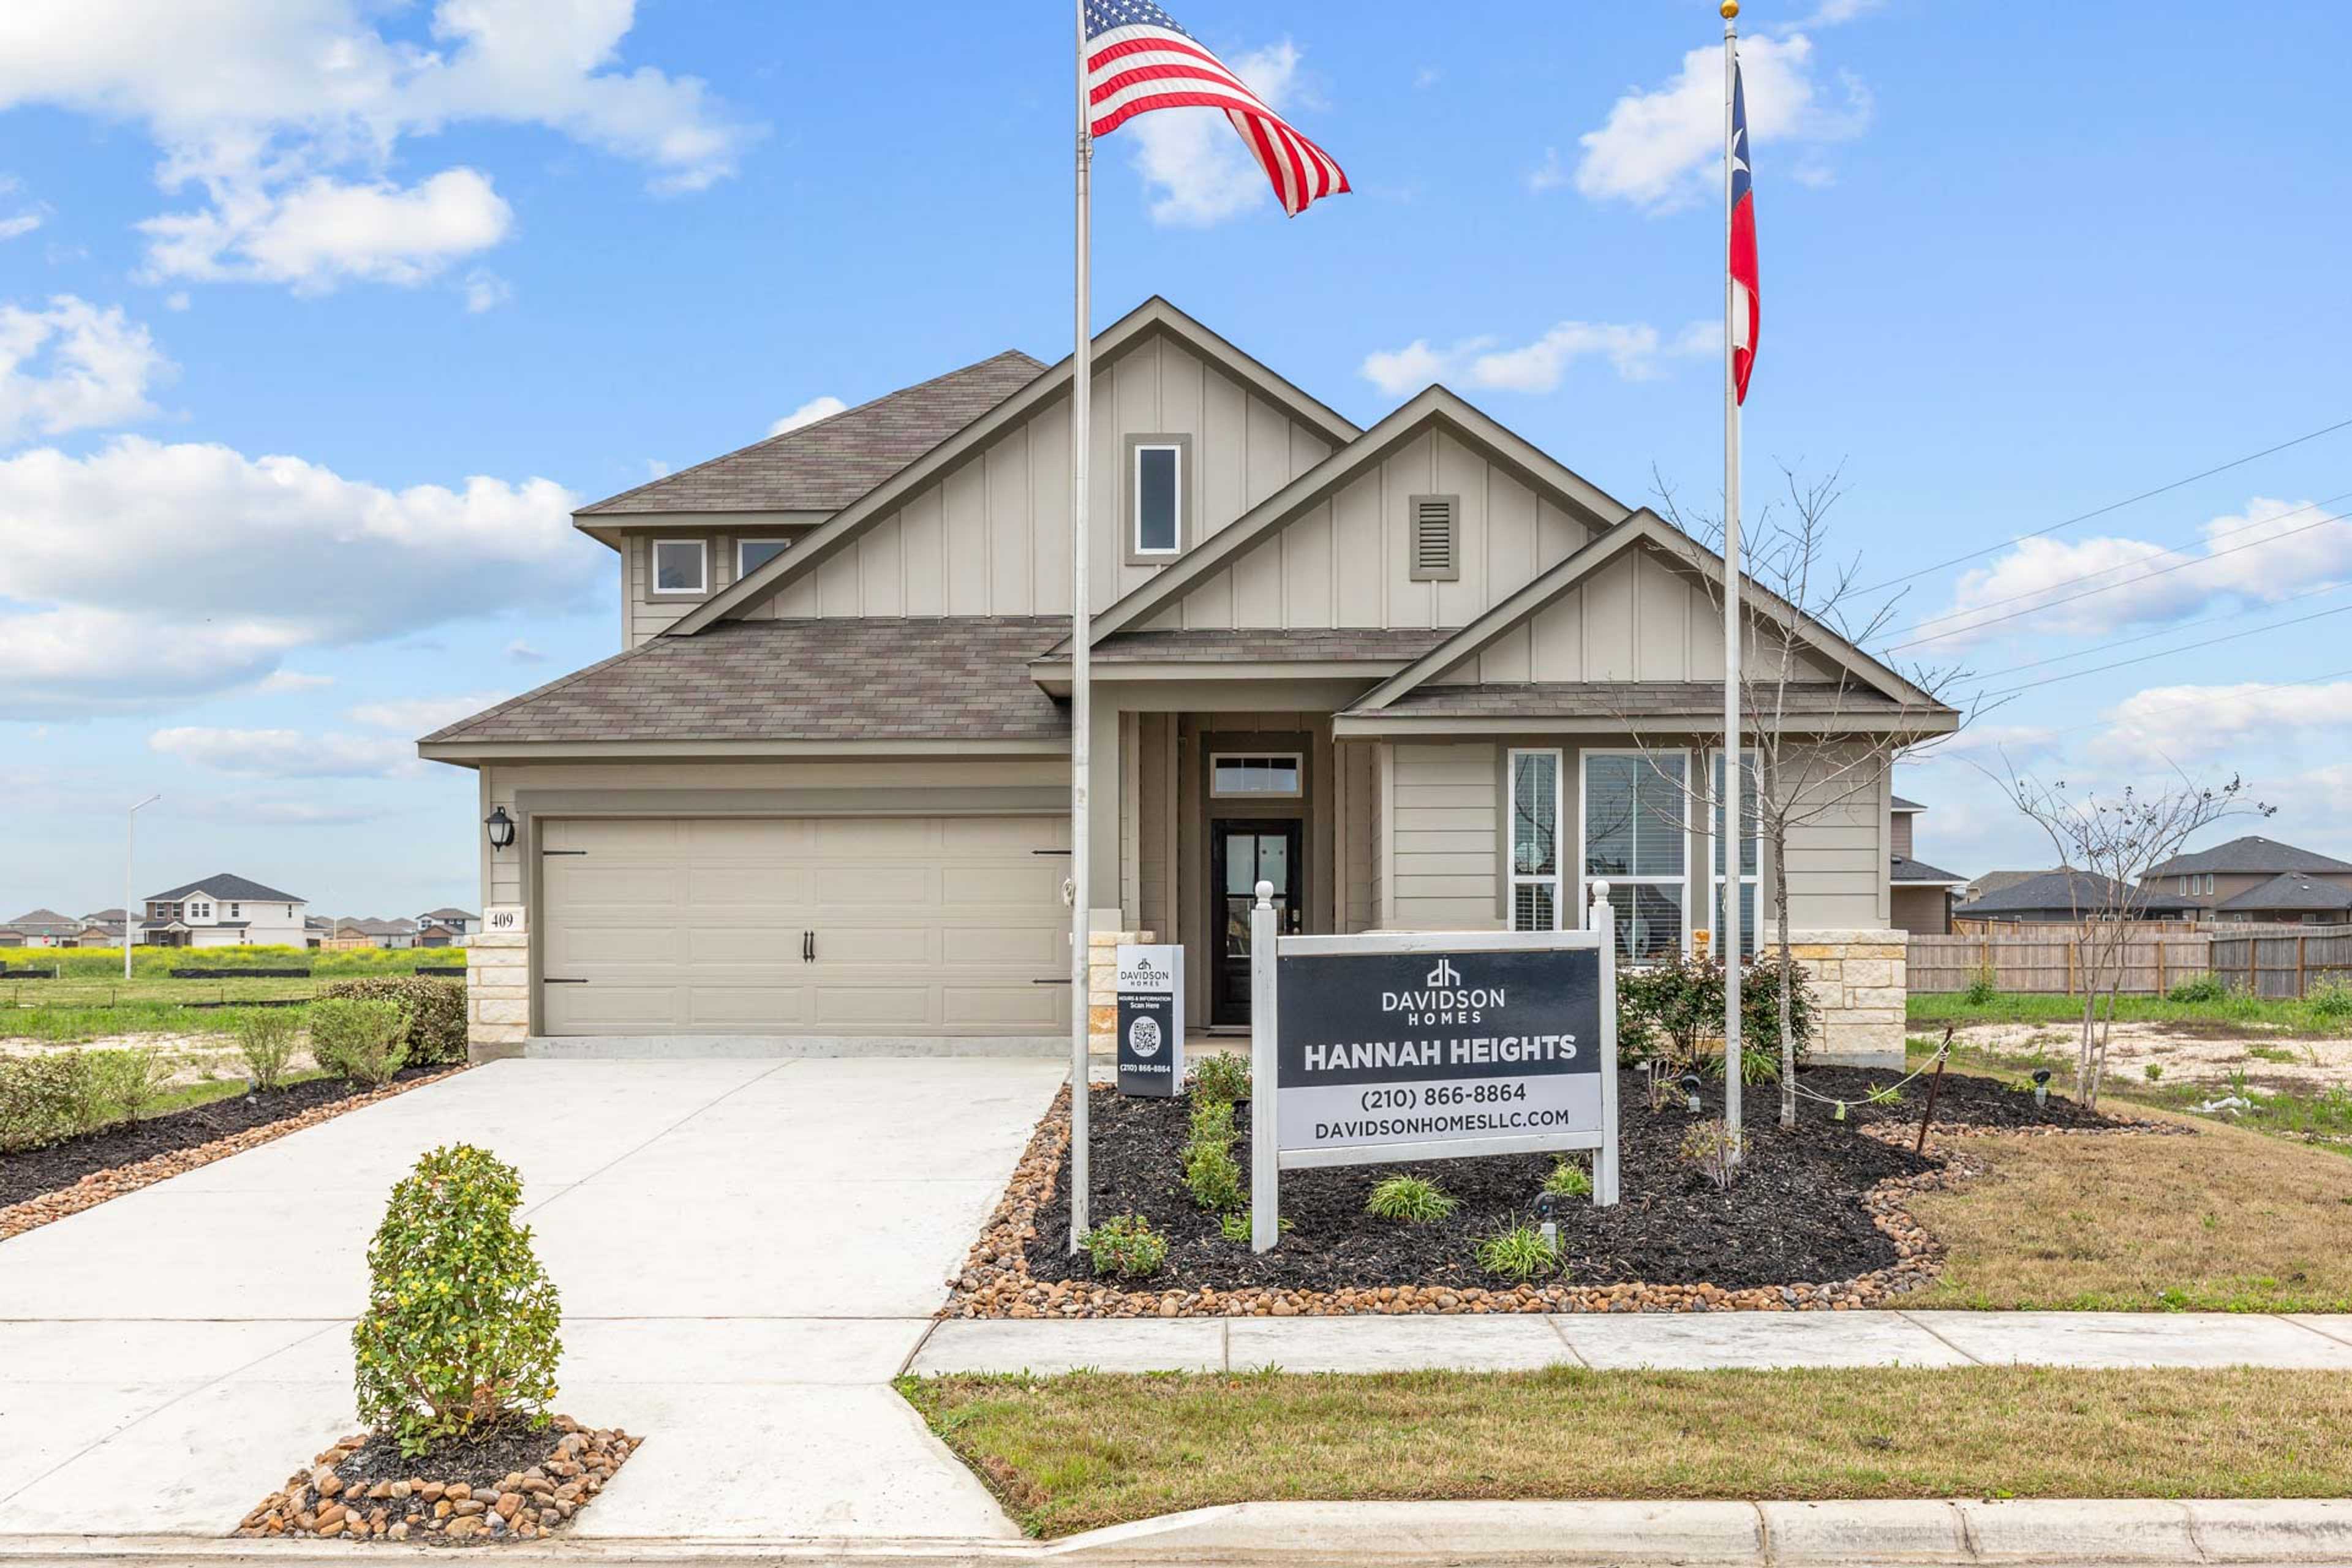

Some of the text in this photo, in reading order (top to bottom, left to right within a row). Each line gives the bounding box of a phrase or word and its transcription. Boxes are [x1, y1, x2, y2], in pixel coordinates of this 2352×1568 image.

[492, 913, 513, 927] 409
[1121, 971, 1169, 980] DAVIDSON
[1382, 989, 1506, 1011] DAVIDSON
[1408, 1011, 1481, 1026] HOMES
[1305, 1035, 1577, 1071] HANNAH HEIGHTS
[1120, 1064, 1138, 1072] (210)
[1361, 1083, 1526, 1112] (210) 866-8864
[1315, 1109, 1569, 1139] DAVIDSONHOMESLLC.COM
